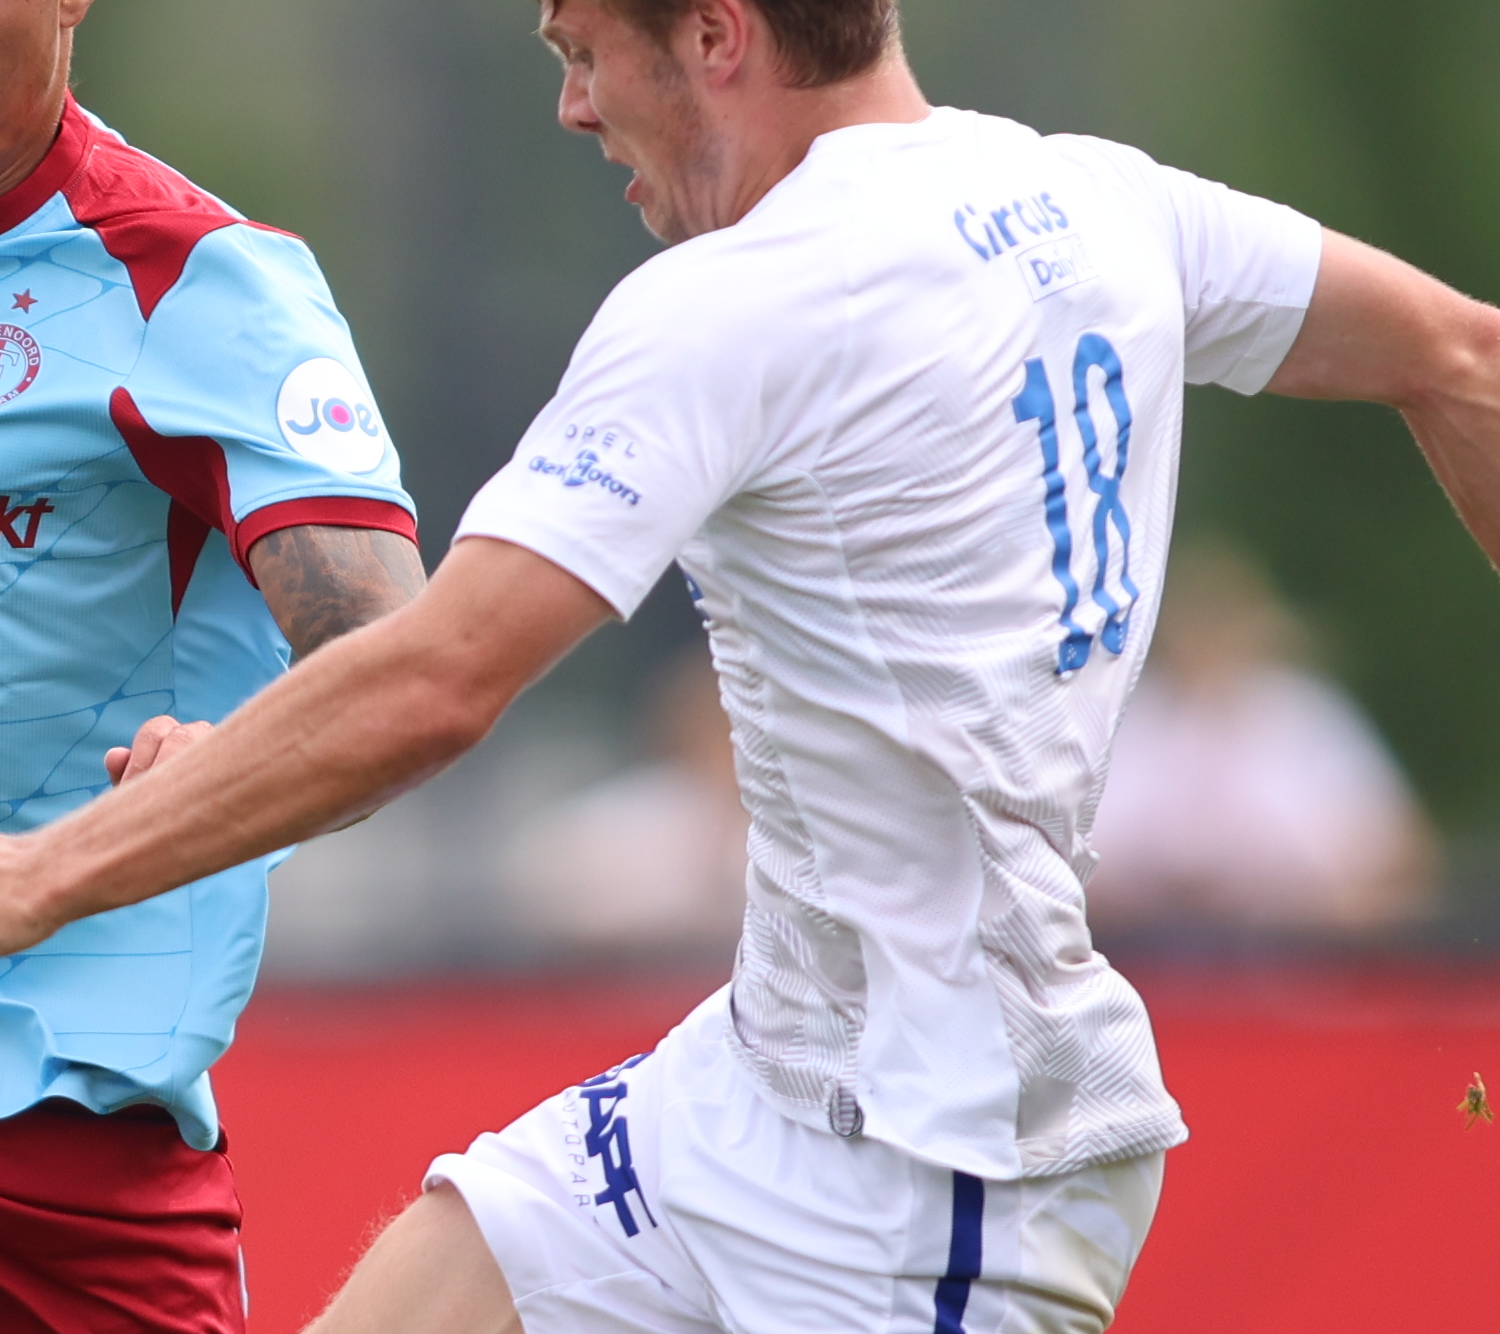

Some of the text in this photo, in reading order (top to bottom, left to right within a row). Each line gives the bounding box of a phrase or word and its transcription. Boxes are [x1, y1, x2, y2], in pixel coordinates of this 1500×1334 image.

[953, 190, 1069, 262] Circus
[564, 424, 636, 459] OPEL
[1011, 330, 1140, 676] 18
